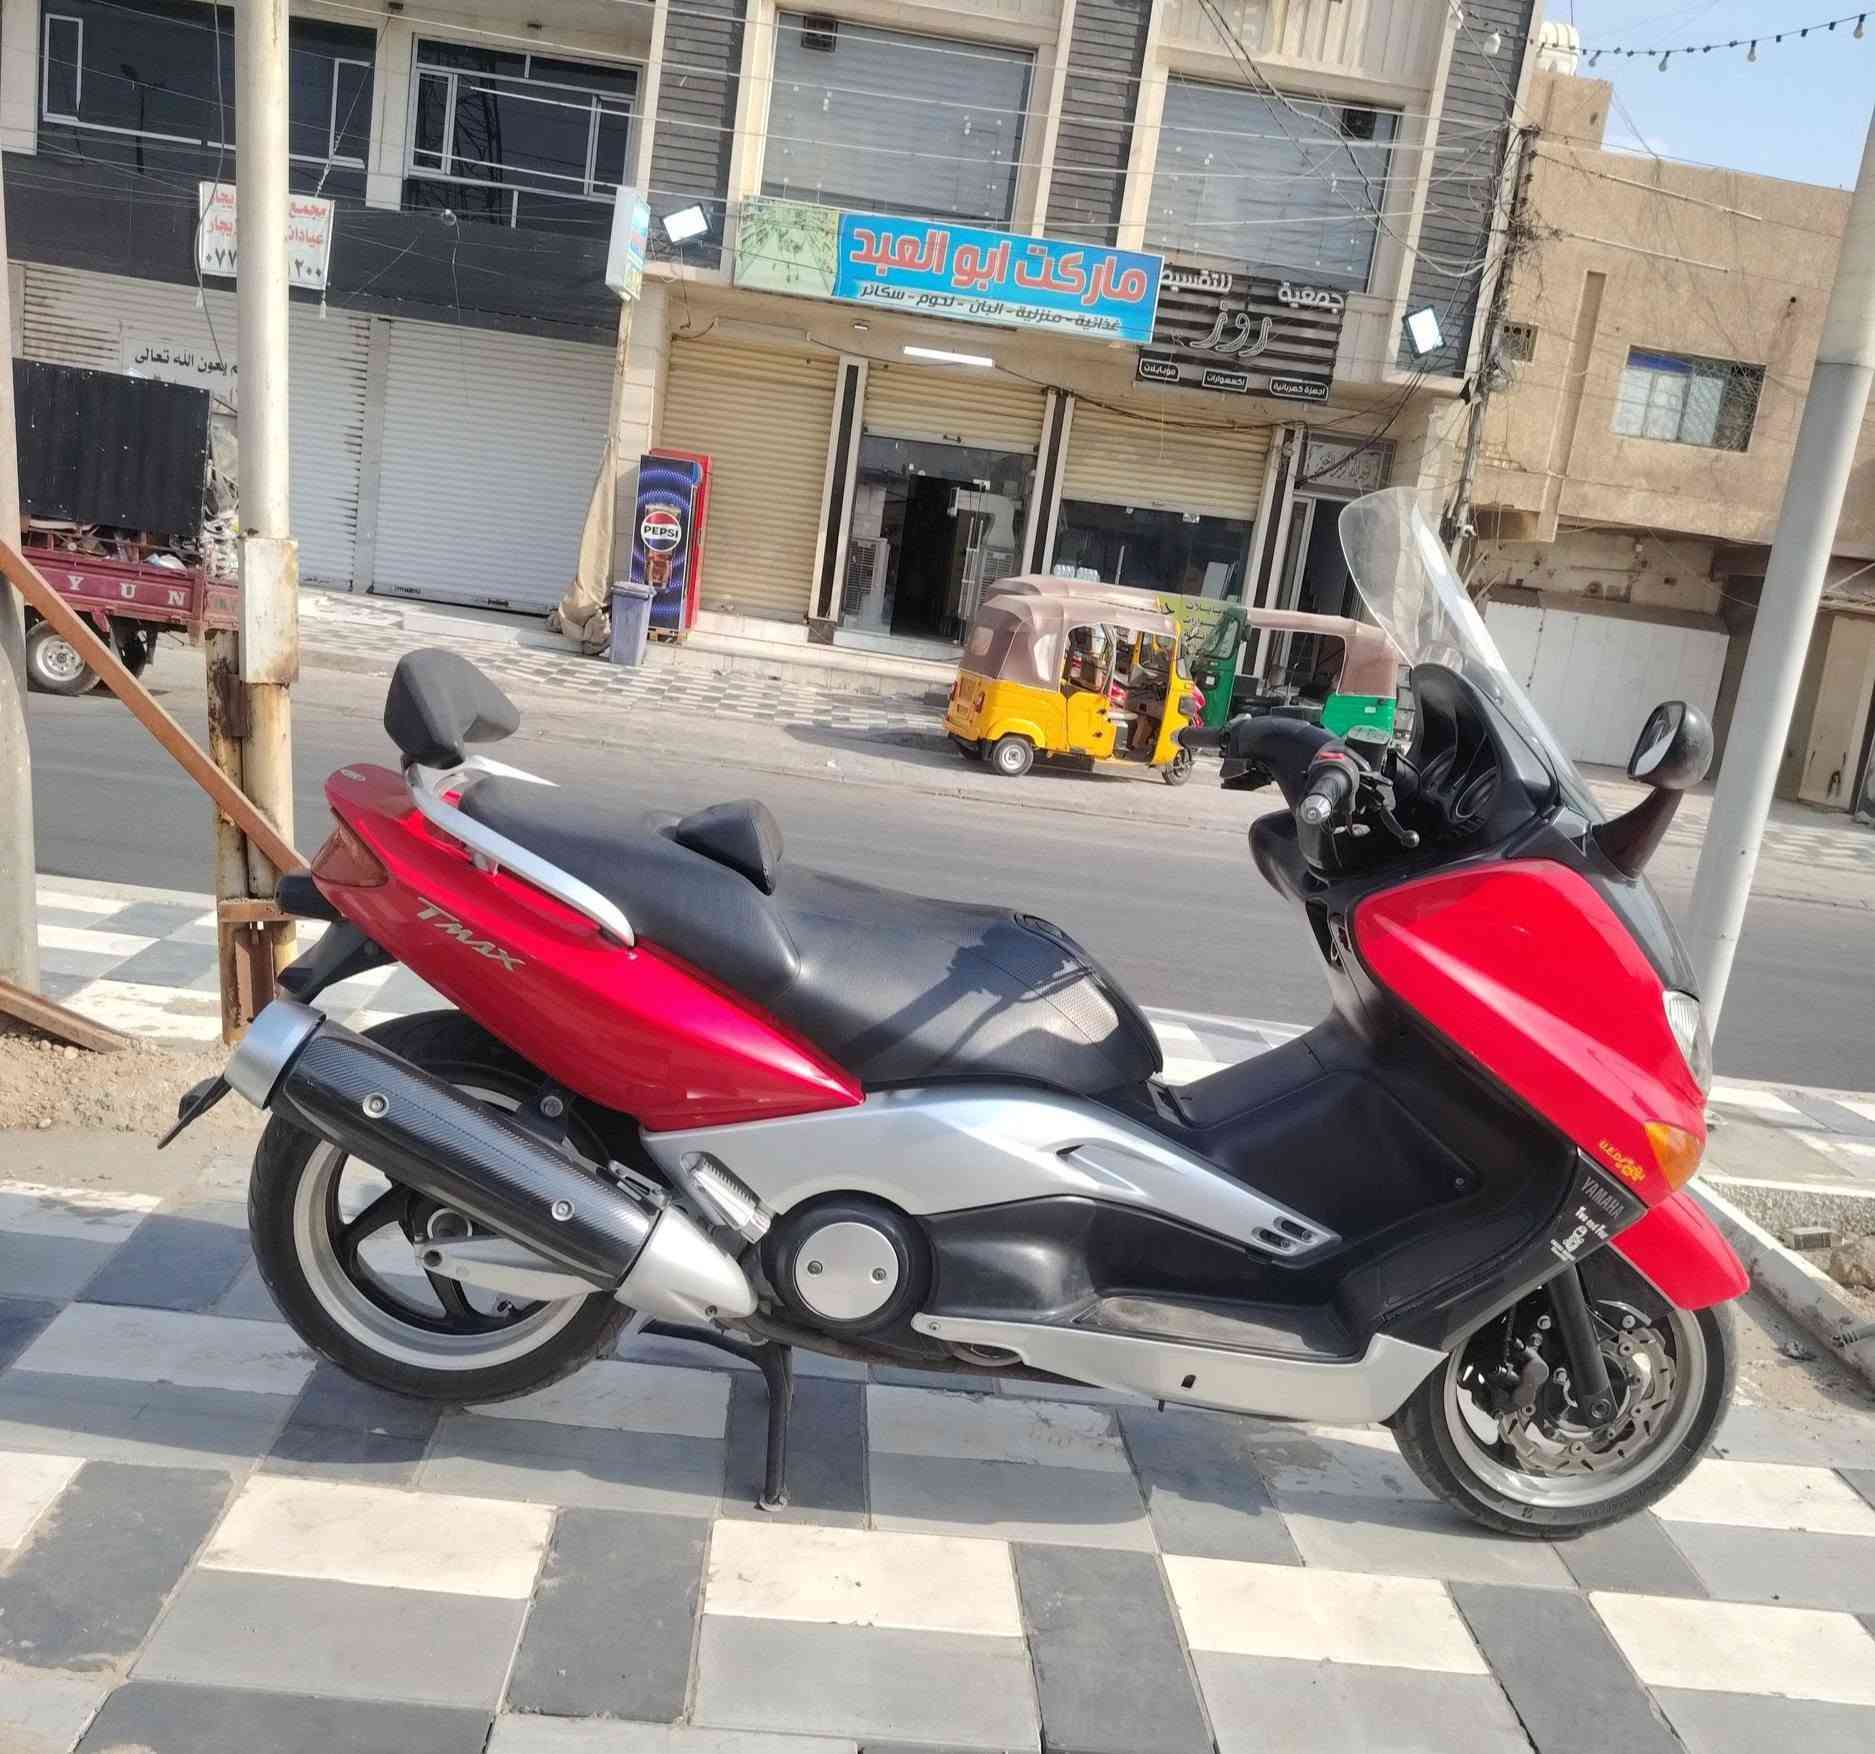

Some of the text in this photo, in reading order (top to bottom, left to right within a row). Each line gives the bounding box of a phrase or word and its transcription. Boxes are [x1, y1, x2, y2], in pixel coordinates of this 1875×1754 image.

[850, 228, 1147, 305] ماركت ابو العبد
[860, 284, 905, 300] سكائر
[916, 293, 955, 307] لحوم
[1278, 281, 1344, 313] جمعية
[135, 347, 169, 364] تعالى
[173, 353, 194, 367] الله
[644, 526, 679, 539] PEPSI
[417, 896, 527, 973] TMAX
[1581, 1177, 1625, 1219] YAMAHA
